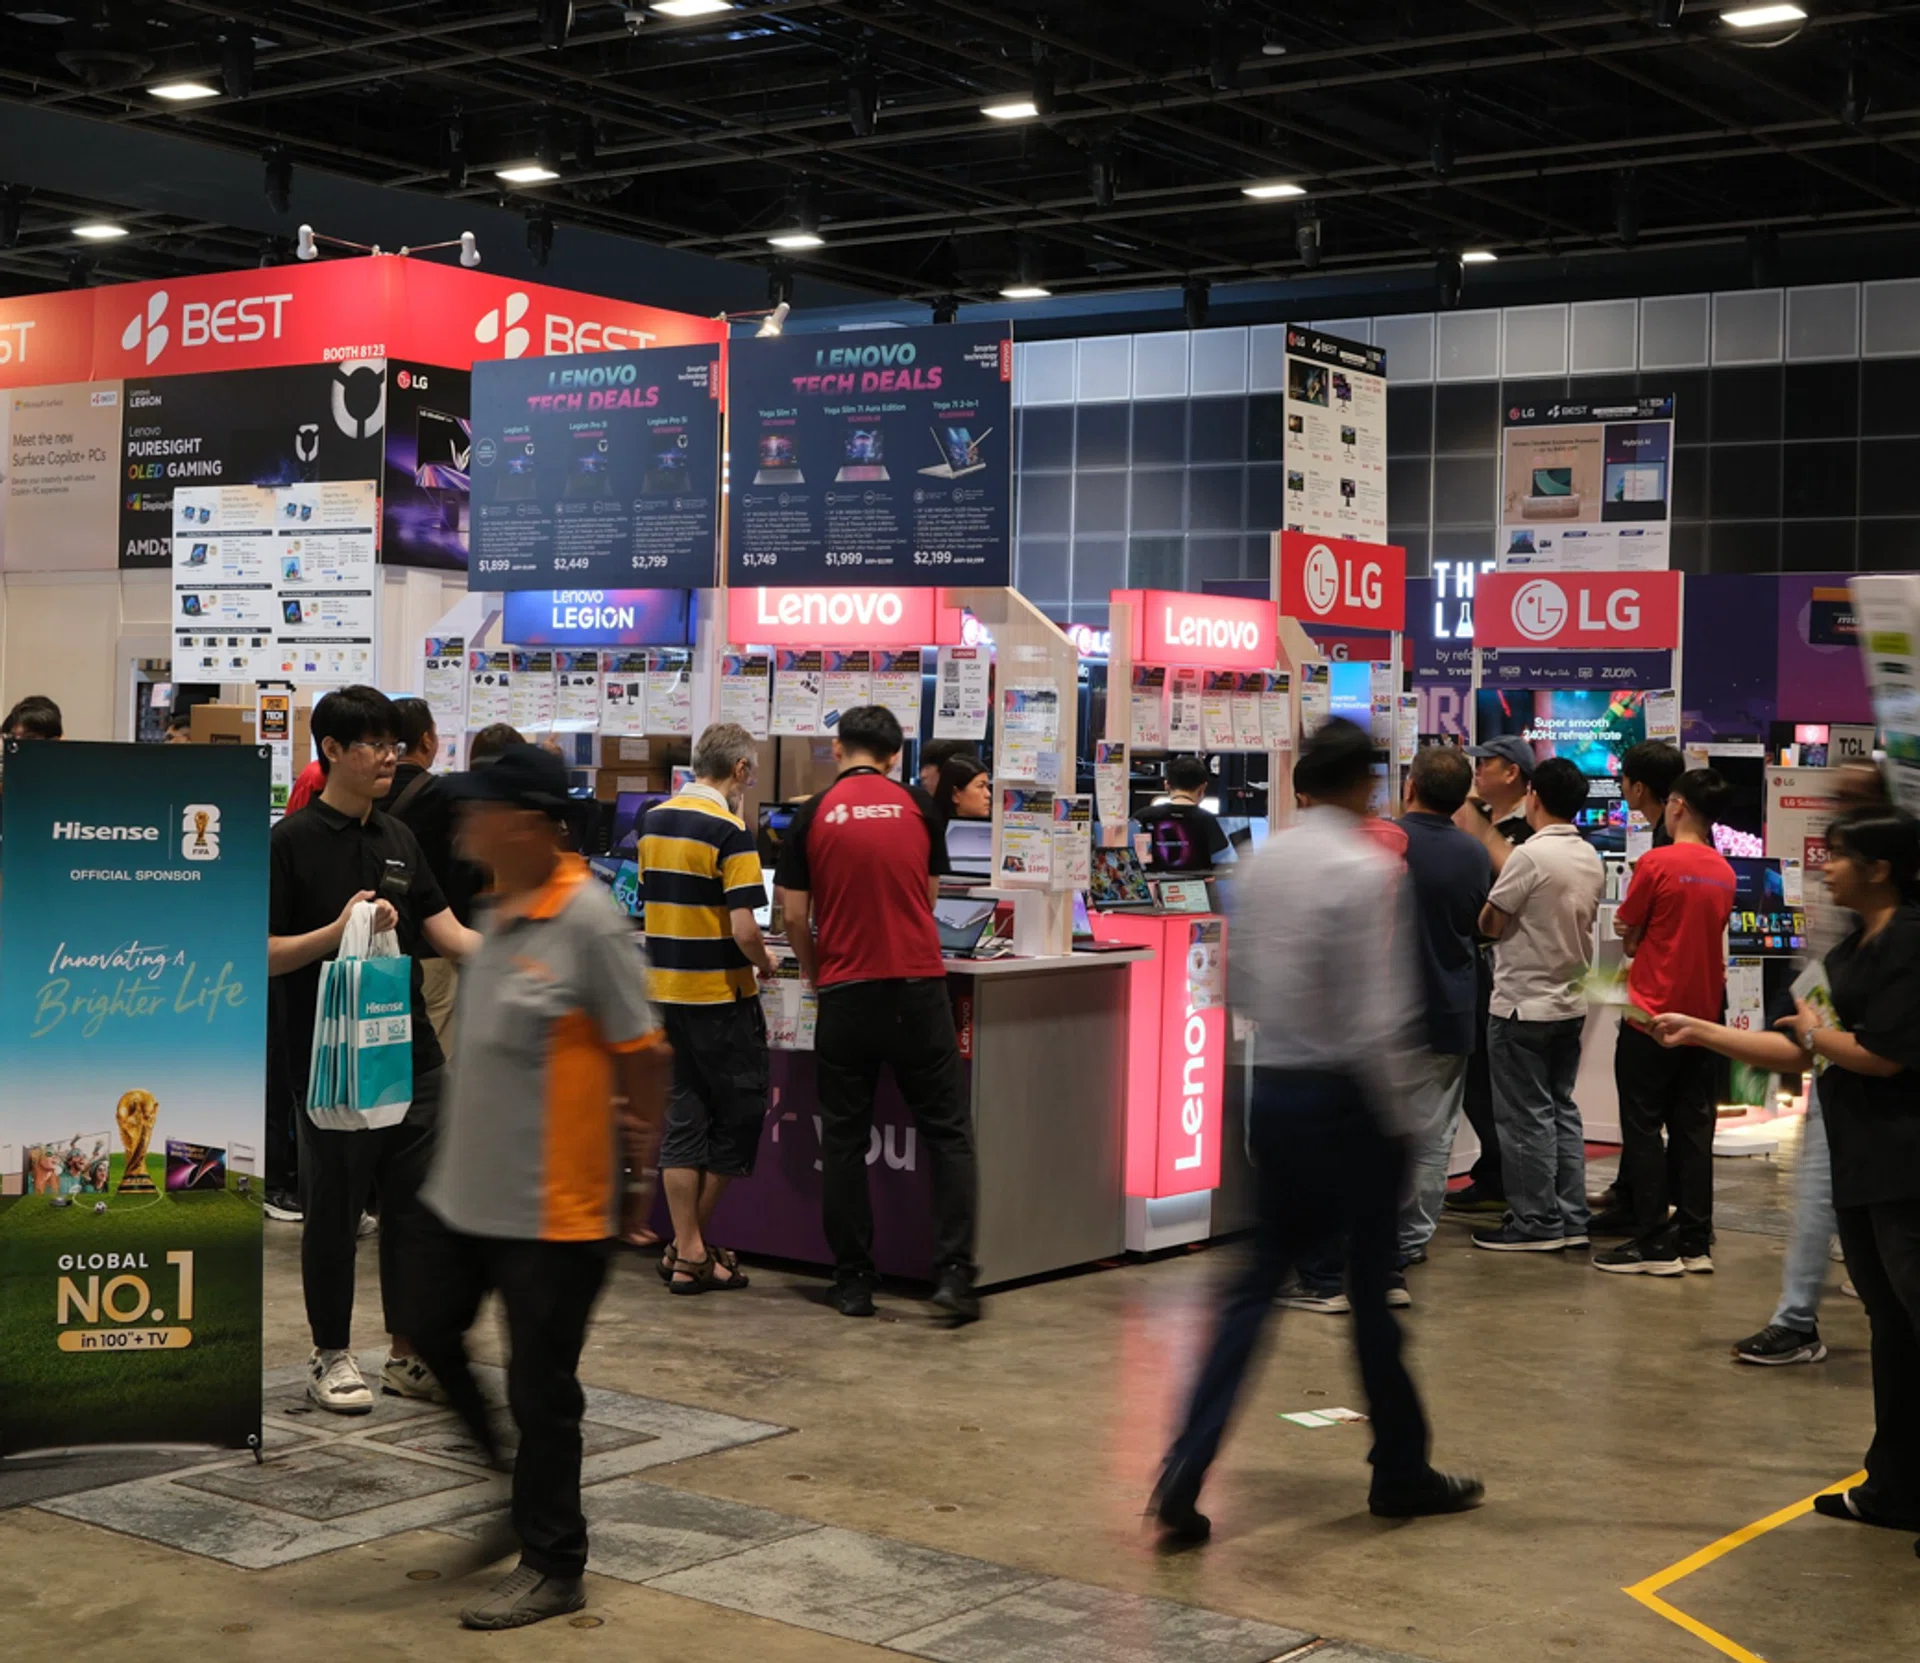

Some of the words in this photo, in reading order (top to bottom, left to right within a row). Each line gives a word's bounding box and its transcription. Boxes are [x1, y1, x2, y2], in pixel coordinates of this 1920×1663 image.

[182, 294, 293, 348] BEST
[323, 347, 358, 361] BOOTH
[360, 344, 386, 358] 8123
[816, 343, 916, 369] LENOVO
[412, 374, 428, 389] LG
[548, 364, 637, 388] LENOVO
[792, 374, 855, 395] TECH
[860, 367, 943, 393] DEALS
[129, 396, 162, 408] LEGION
[527, 393, 583, 413] TECH
[587, 386, 660, 411] DEALS
[933, 402, 951, 411] Yoga
[759, 410, 775, 419] Yoga
[776, 409, 791, 417] Slim
[824, 407, 841, 416] Yoga
[842, 406, 856, 414] Slim
[865, 405, 881, 413] Aura
[882, 403, 907, 412] Edition
[1521, 408, 1535, 418] LG
[1561, 405, 1588, 416] BEST
[647, 417, 668, 427] Legion
[13, 434, 36, 447] Meet
[38, 433, 53, 445] the
[54, 434, 73, 444] new
[129, 426, 162, 438] Lenovo
[128, 438, 203, 457] PURESIGHT
[1622, 439, 1643, 447] Hybrid
[12, 451, 45, 467] Surface
[48, 449, 85, 467] Copilot+
[88, 447, 107, 461] PCs
[128, 463, 164, 479] OLED
[166, 460, 223, 478] GAMING
[126, 539, 158, 556] AMD
[478, 559, 510, 573] $1,899
[553, 557, 589, 571] $2,449
[632, 555, 668, 569] $2,799
[742, 552, 777, 568] $1,749
[825, 552, 863, 567] $1,999
[913, 551, 952, 566] $2,199
[1344, 559, 1382, 608] LG
[553, 588, 604, 604] Lenovo
[757, 586, 903, 626] Lenovo
[1578, 588, 1641, 631] LG
[553, 606, 634, 630] LEGION
[1165, 606, 1259, 650] Lenovo
[1319, 643, 1349, 662] LG
[1436, 649, 1450, 663] by
[874, 672, 905, 680] LENOVO
[1534, 717, 1566, 730] Super
[1568, 717, 1609, 728] smooth
[1522, 729, 1557, 741] 240Hz
[1558, 728, 1597, 741] refresh
[1599, 729, 1622, 741] rate
[1838, 737, 1866, 756] TCL
[1784, 777, 1795, 787] LG
[852, 803, 904, 820] BEST
[52, 821, 159, 841] Hisense
[192, 848, 210, 856] FIFA
[70, 870, 132, 881] OFFICIAL
[135, 870, 201, 881] SPONSOR
[49, 940, 169, 980] Innovating
[30, 976, 166, 1038] Brighter
[174, 960, 246, 1024] Life
[366, 1002, 404, 1014] Hisense
[960, 1001, 970, 1054] Lenovo
[58, 1252, 149, 1270] GLOBAL
[57, 1250, 194, 1325] NO.1
[81, 1333, 96, 1348] in
[147, 1332, 169, 1346] TV
